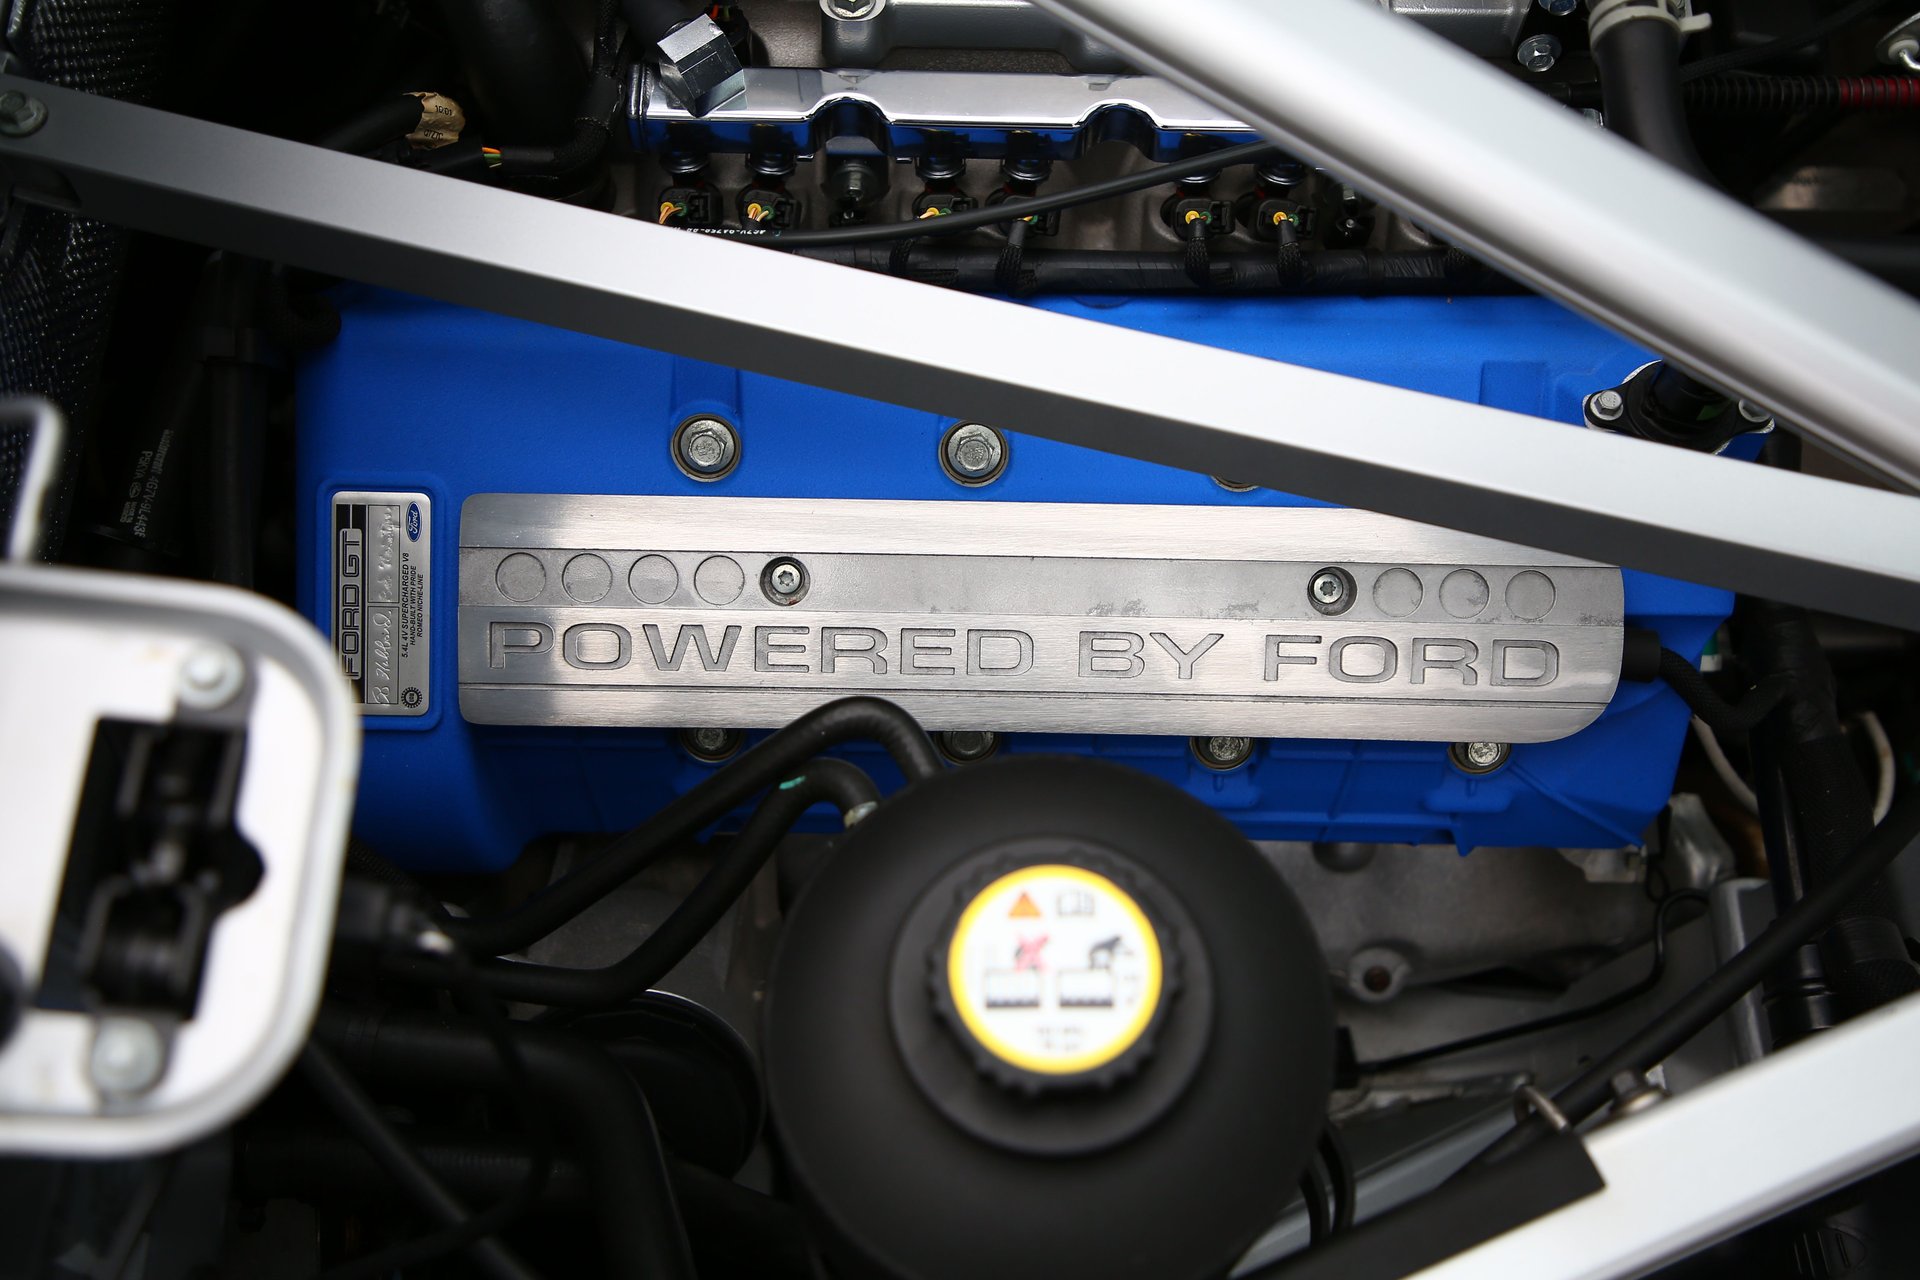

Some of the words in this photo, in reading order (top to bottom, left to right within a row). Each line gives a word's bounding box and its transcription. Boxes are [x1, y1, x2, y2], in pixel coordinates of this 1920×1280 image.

[341, 530, 359, 578] GT
[402, 552, 410, 563] V8
[402, 564, 410, 630] SUPERCHARGED
[341, 584, 359, 677] FORD
[402, 630, 409, 642] 4V
[488, 620, 1035, 676] POWERED
[1077, 630, 1225, 680] BY
[1264, 634, 1560, 687] FORD
